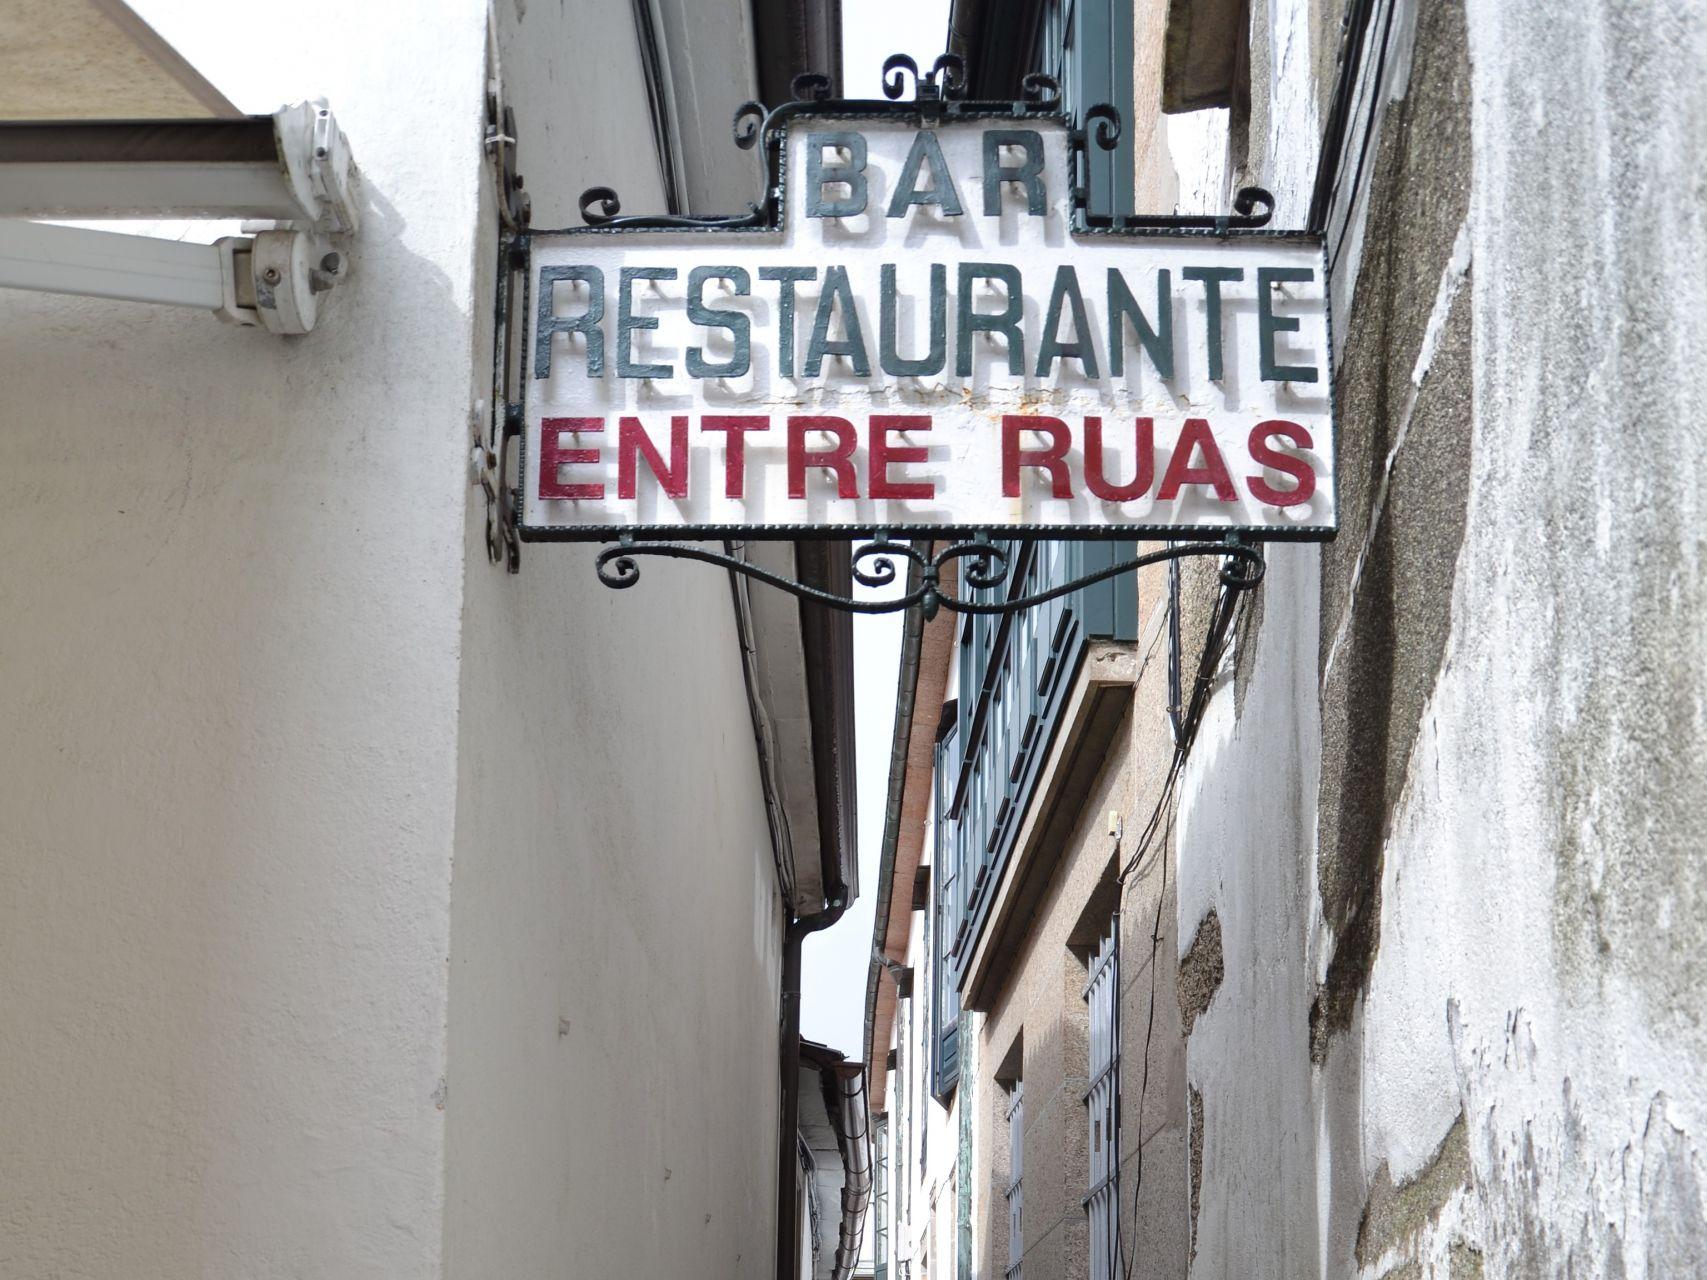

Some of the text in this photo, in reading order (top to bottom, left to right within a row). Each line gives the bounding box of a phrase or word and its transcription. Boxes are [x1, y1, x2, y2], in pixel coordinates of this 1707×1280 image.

[806, 130, 1047, 217] BAR
[534, 263, 1318, 383] RESTAURANTE
[539, 415, 1316, 506] ENTRE RUAS
